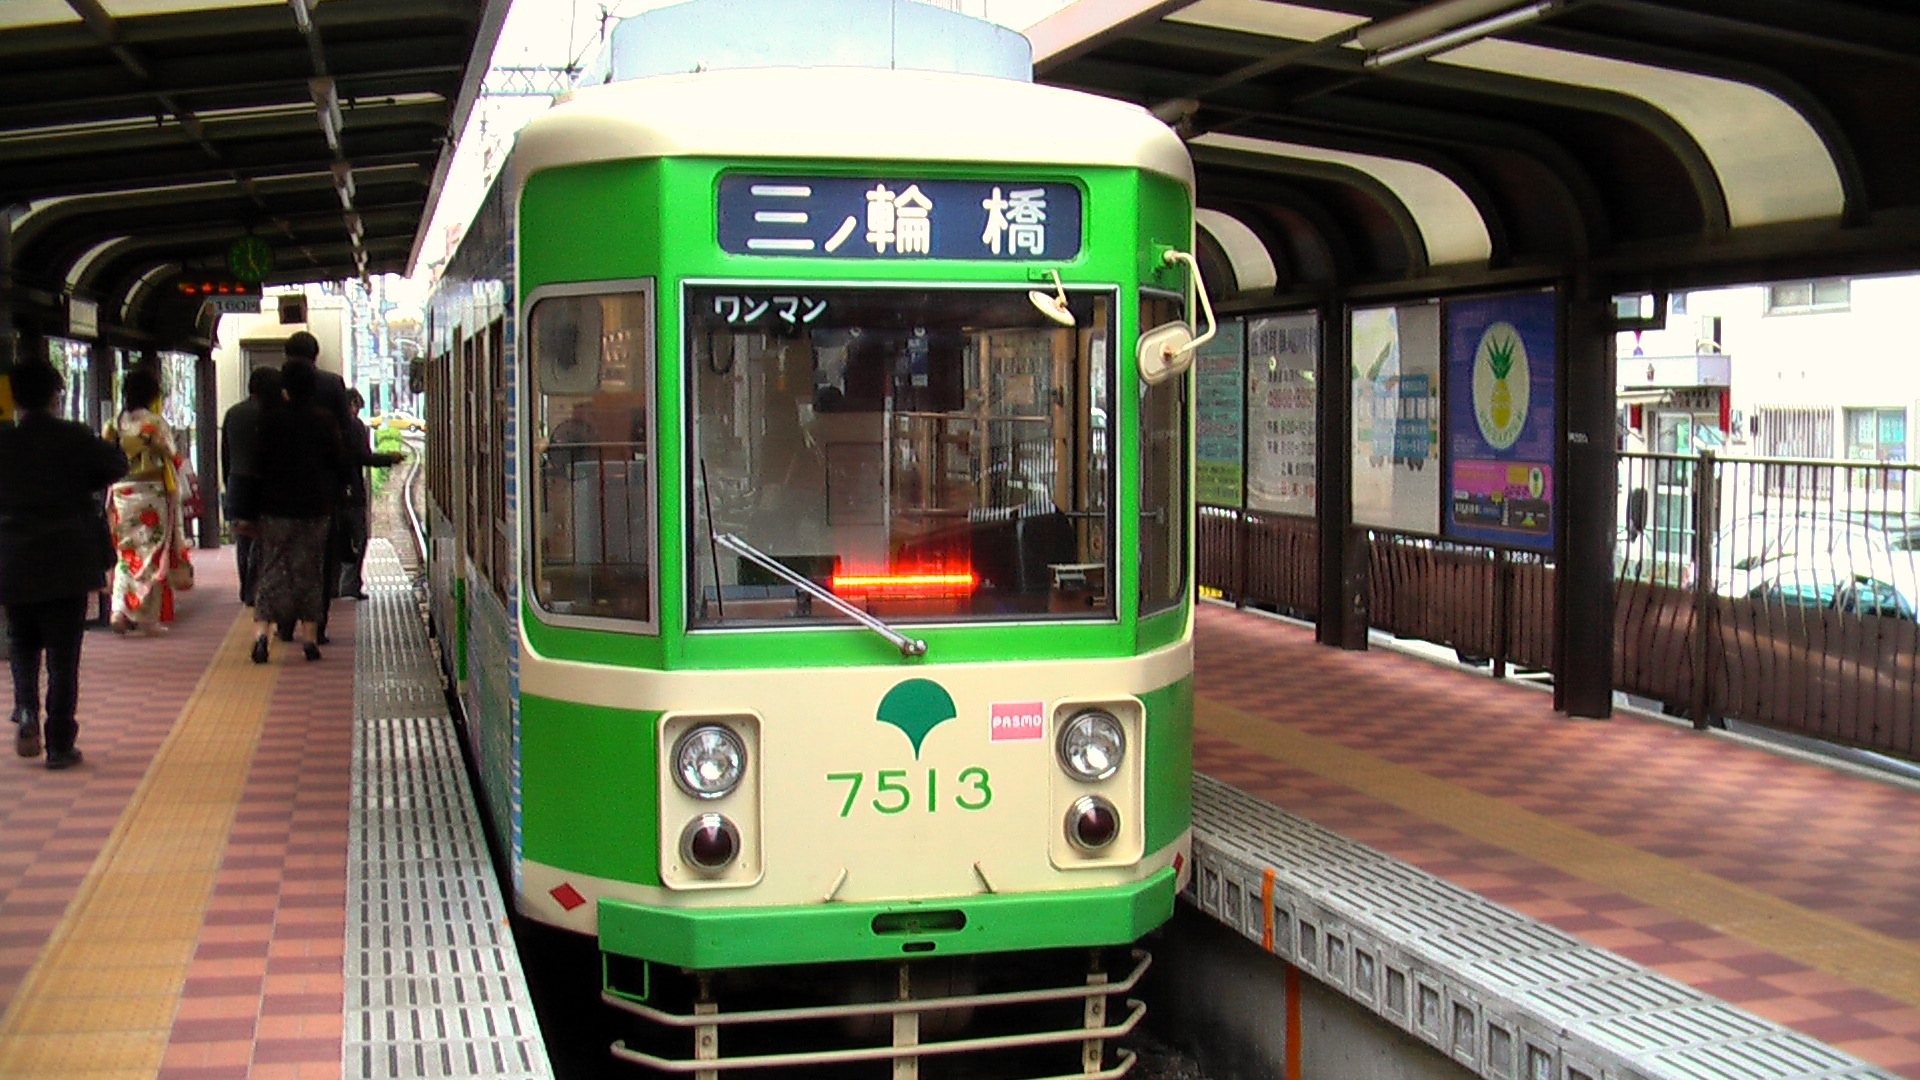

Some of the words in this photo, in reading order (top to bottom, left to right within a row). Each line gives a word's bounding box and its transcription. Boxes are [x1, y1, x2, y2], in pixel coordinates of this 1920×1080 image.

[714, 295, 827, 325] ワンマン
[992, 714, 1042, 729] PASMO
[826, 766, 993, 818] 7513
